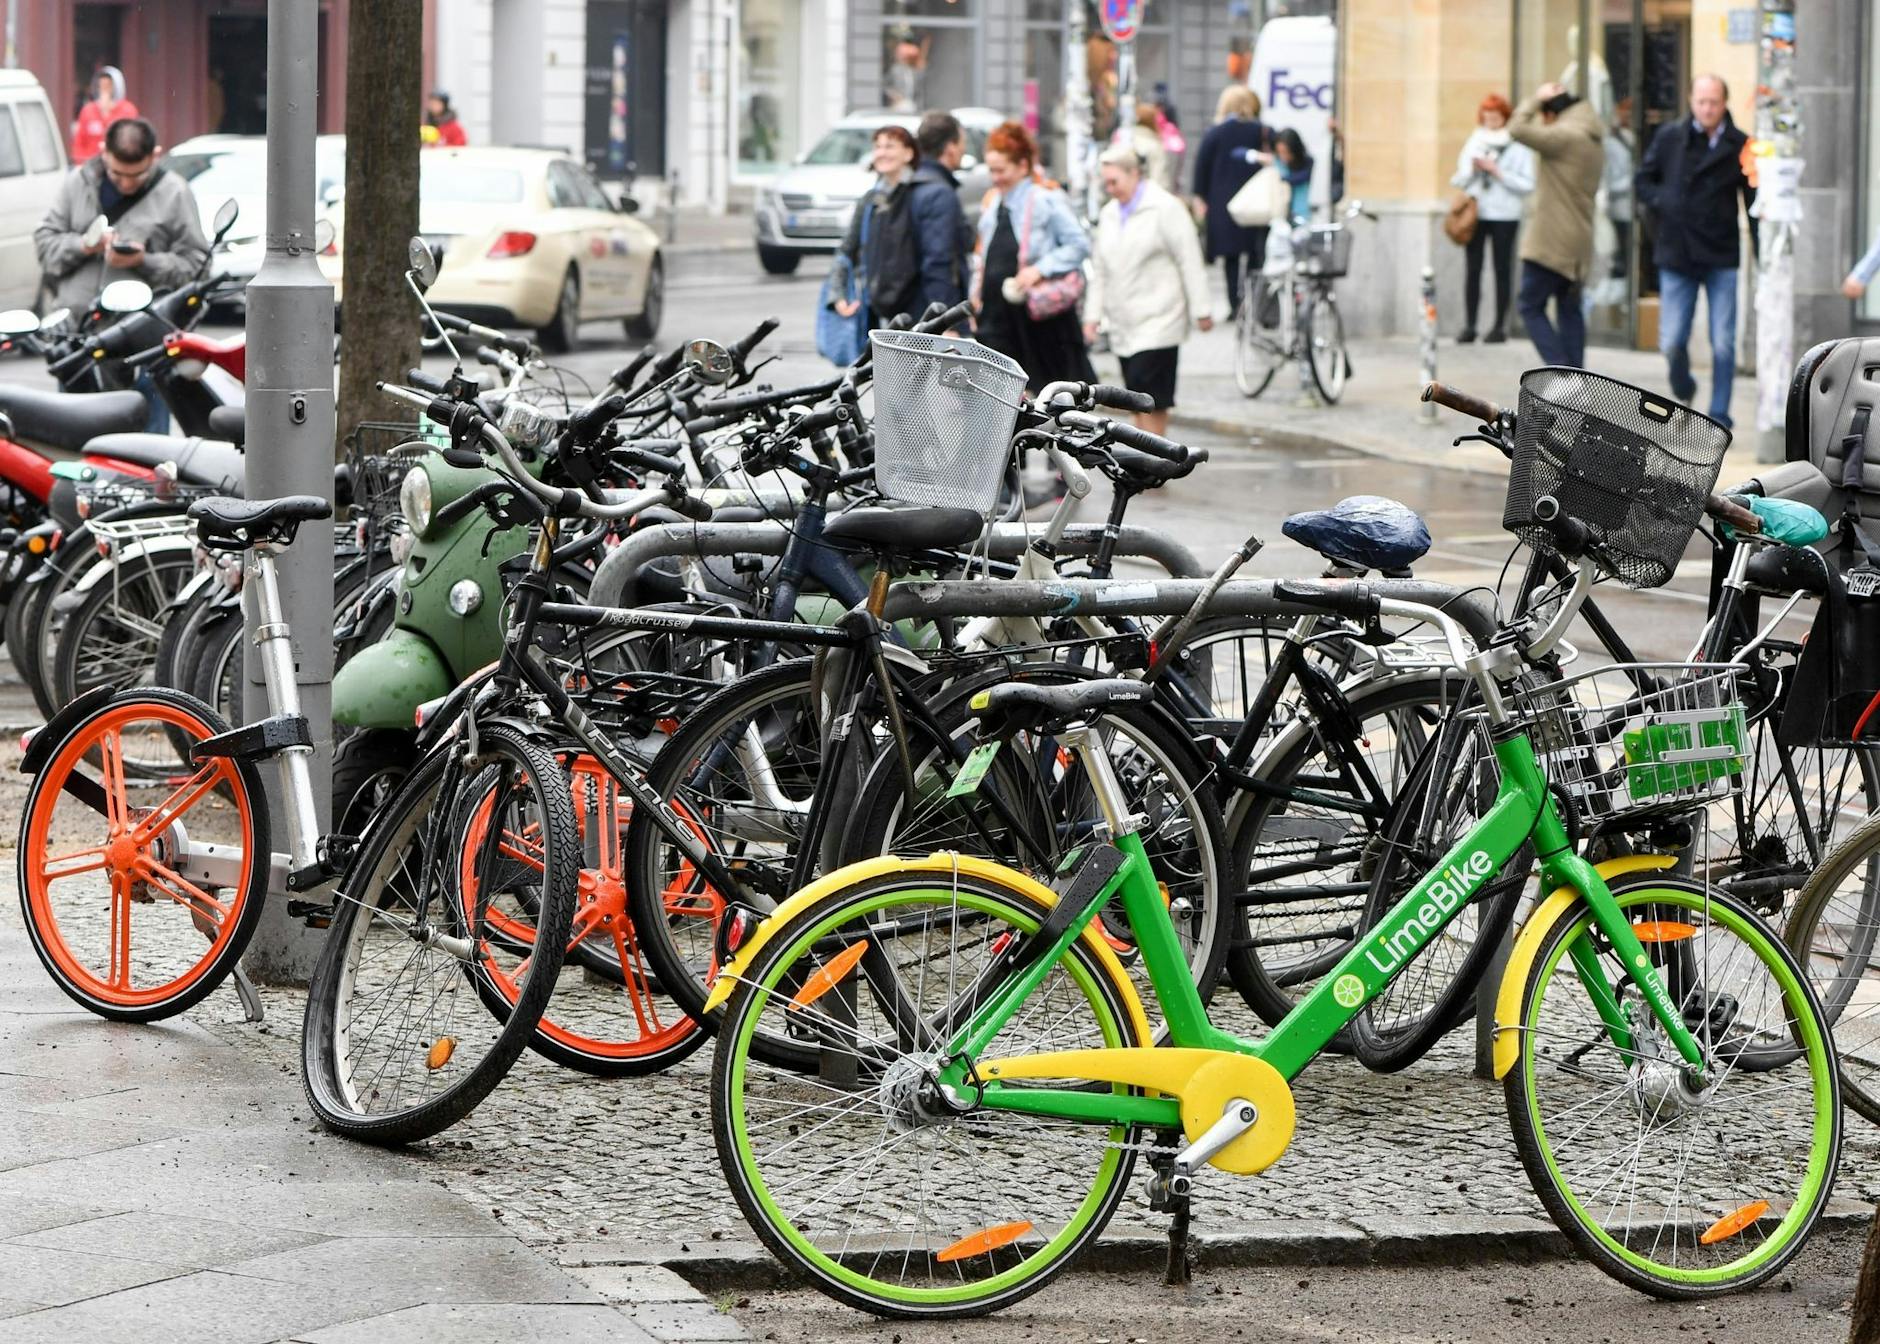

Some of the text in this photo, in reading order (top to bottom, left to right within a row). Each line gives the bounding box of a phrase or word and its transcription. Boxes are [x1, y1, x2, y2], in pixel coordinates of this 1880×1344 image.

[608, 612, 687, 629] RoadCruiser
[1108, 691, 1141, 701] LimeBike
[587, 728, 697, 842] Prince
[1365, 850, 1493, 973] LimeBike
[1645, 970, 1685, 1031] LimeBike
